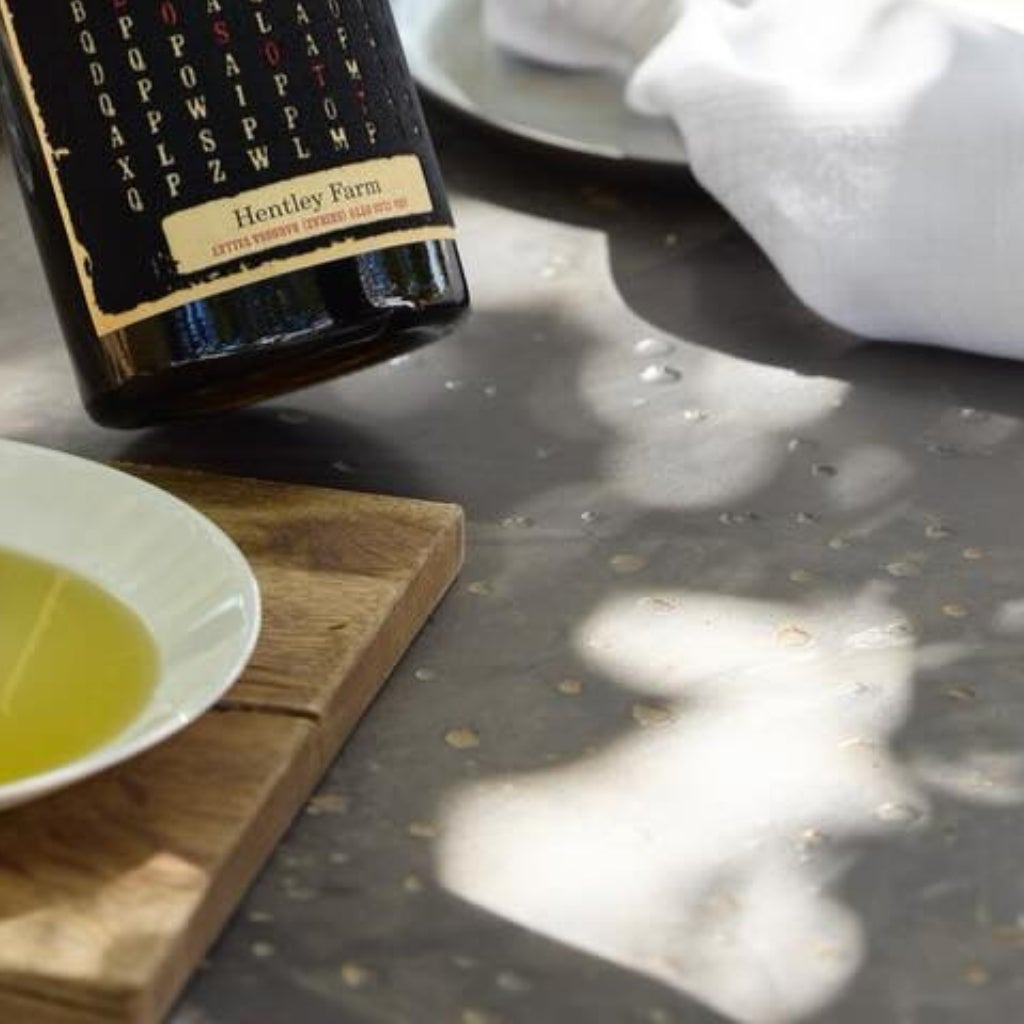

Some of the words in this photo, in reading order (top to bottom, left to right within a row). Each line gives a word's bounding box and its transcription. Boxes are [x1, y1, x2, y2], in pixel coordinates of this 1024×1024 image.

[119, 15, 134, 40] P
[170, 33, 185, 58] P
[213, 20, 230, 45] S
[137, 78, 153, 103] P
[179, 65, 197, 89] O
[225, 52, 241, 77] A
[110, 124, 125, 149] A
[146, 110, 162, 135] P
[184, 94, 207, 121] W
[273, 72, 288, 97] P
[117, 155, 136, 182] X
[156, 142, 175, 168] L
[198, 127, 217, 153] S
[242, 116, 258, 141] P
[283, 105, 298, 130] P
[166, 172, 181, 198] P
[207, 158, 227, 184] Z
[246, 143, 270, 172] W
[291, 136, 312, 160] L
[233, 192, 324, 228] Hentley
[329, 179, 382, 203] Farm
